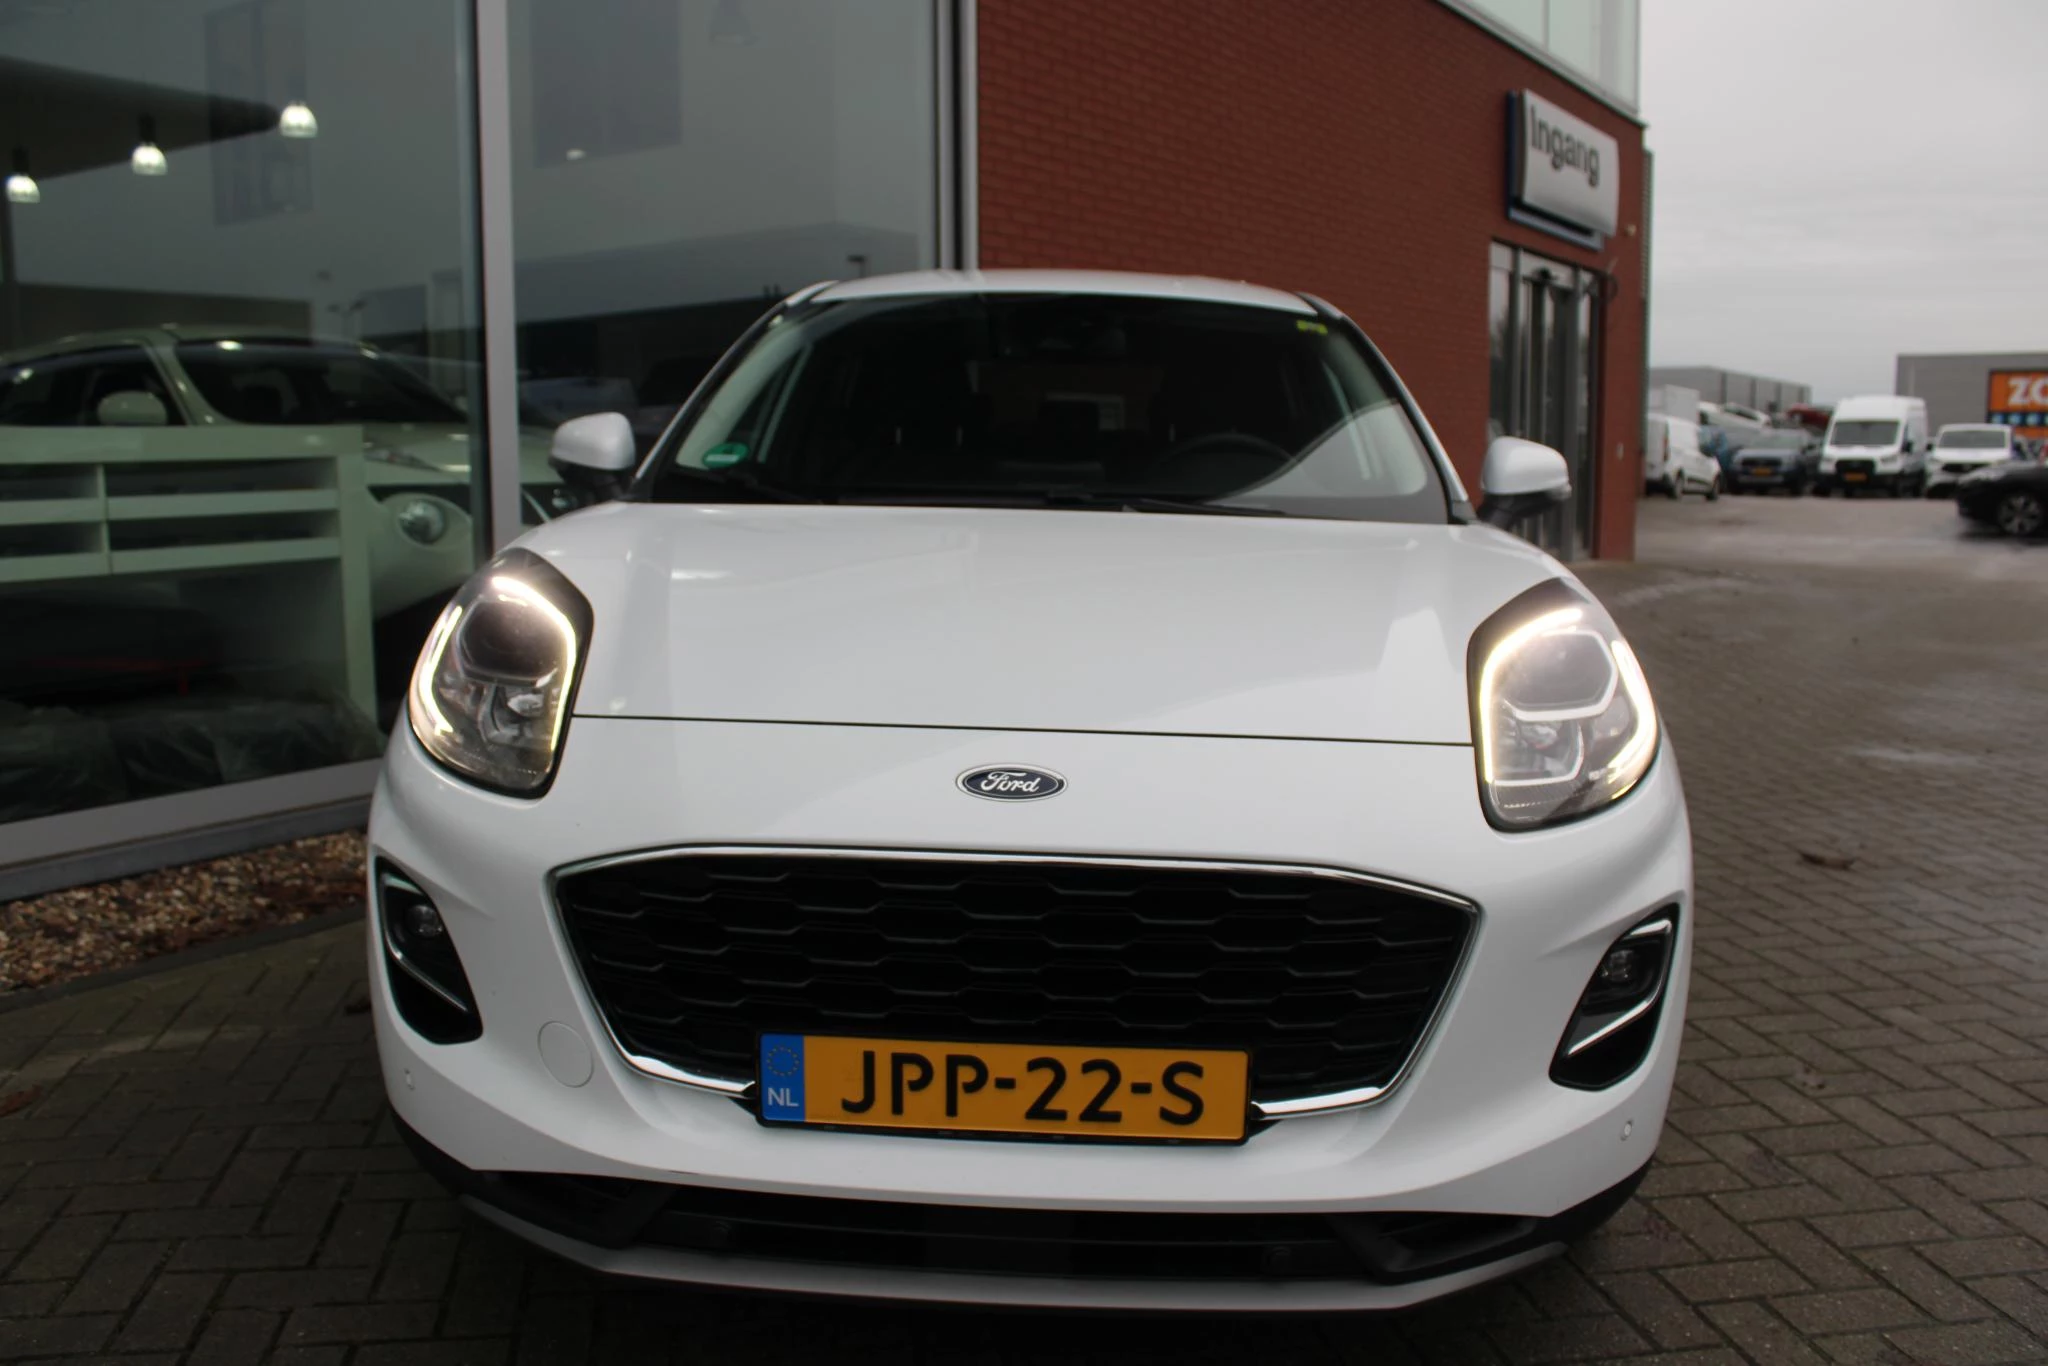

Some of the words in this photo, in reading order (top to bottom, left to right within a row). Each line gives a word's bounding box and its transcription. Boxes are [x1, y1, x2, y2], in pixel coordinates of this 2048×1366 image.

[1530, 103, 1599, 187] Ingang
[980, 770, 1041, 792] Ford
[767, 1087, 799, 1107] NL
[841, 1050, 1204, 1125] JPP-22-S
